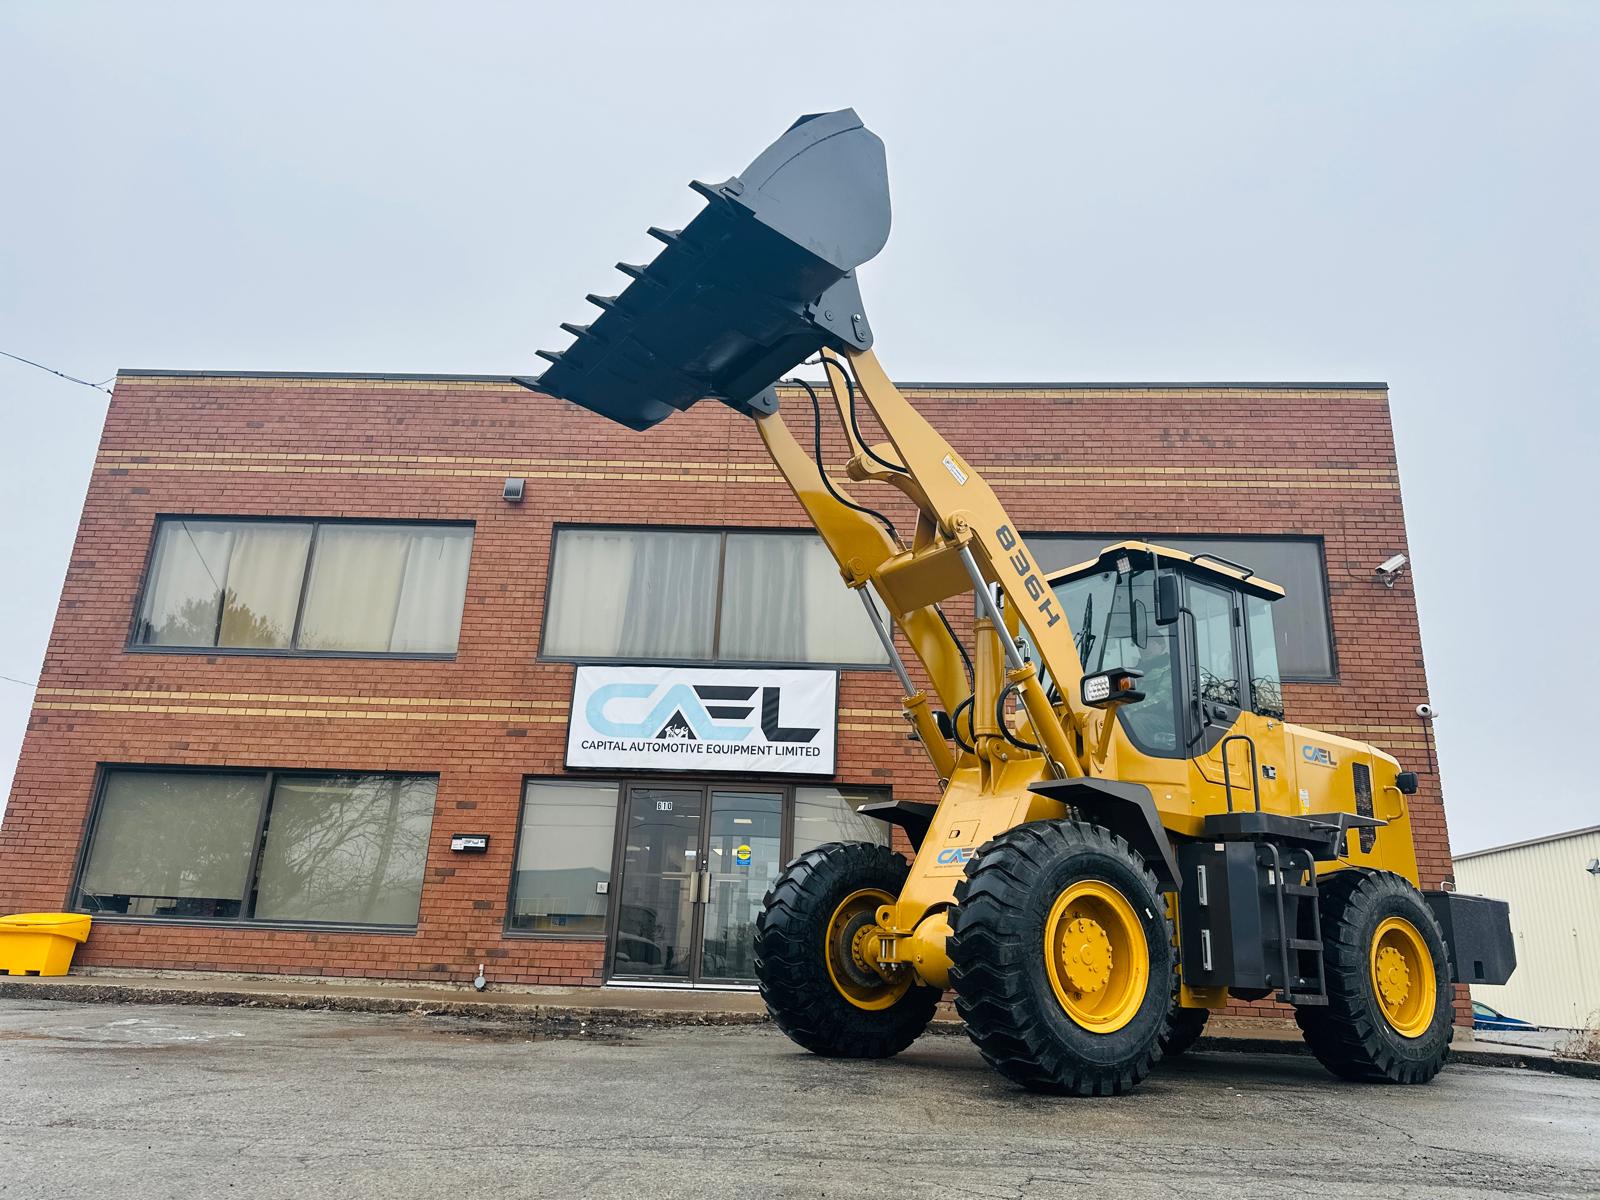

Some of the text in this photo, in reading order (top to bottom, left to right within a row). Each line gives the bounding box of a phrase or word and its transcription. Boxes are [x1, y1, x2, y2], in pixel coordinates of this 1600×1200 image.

[995, 524, 1061, 628] 836H
[585, 683, 821, 743] CAEL
[581, 740, 821, 757] CAPITAL AUTOMOTIVE EQUIPMENT LIMITED
[1302, 746, 1337, 765] CAEL
[657, 801, 672, 810] 610
[937, 848, 975, 864] CAE
